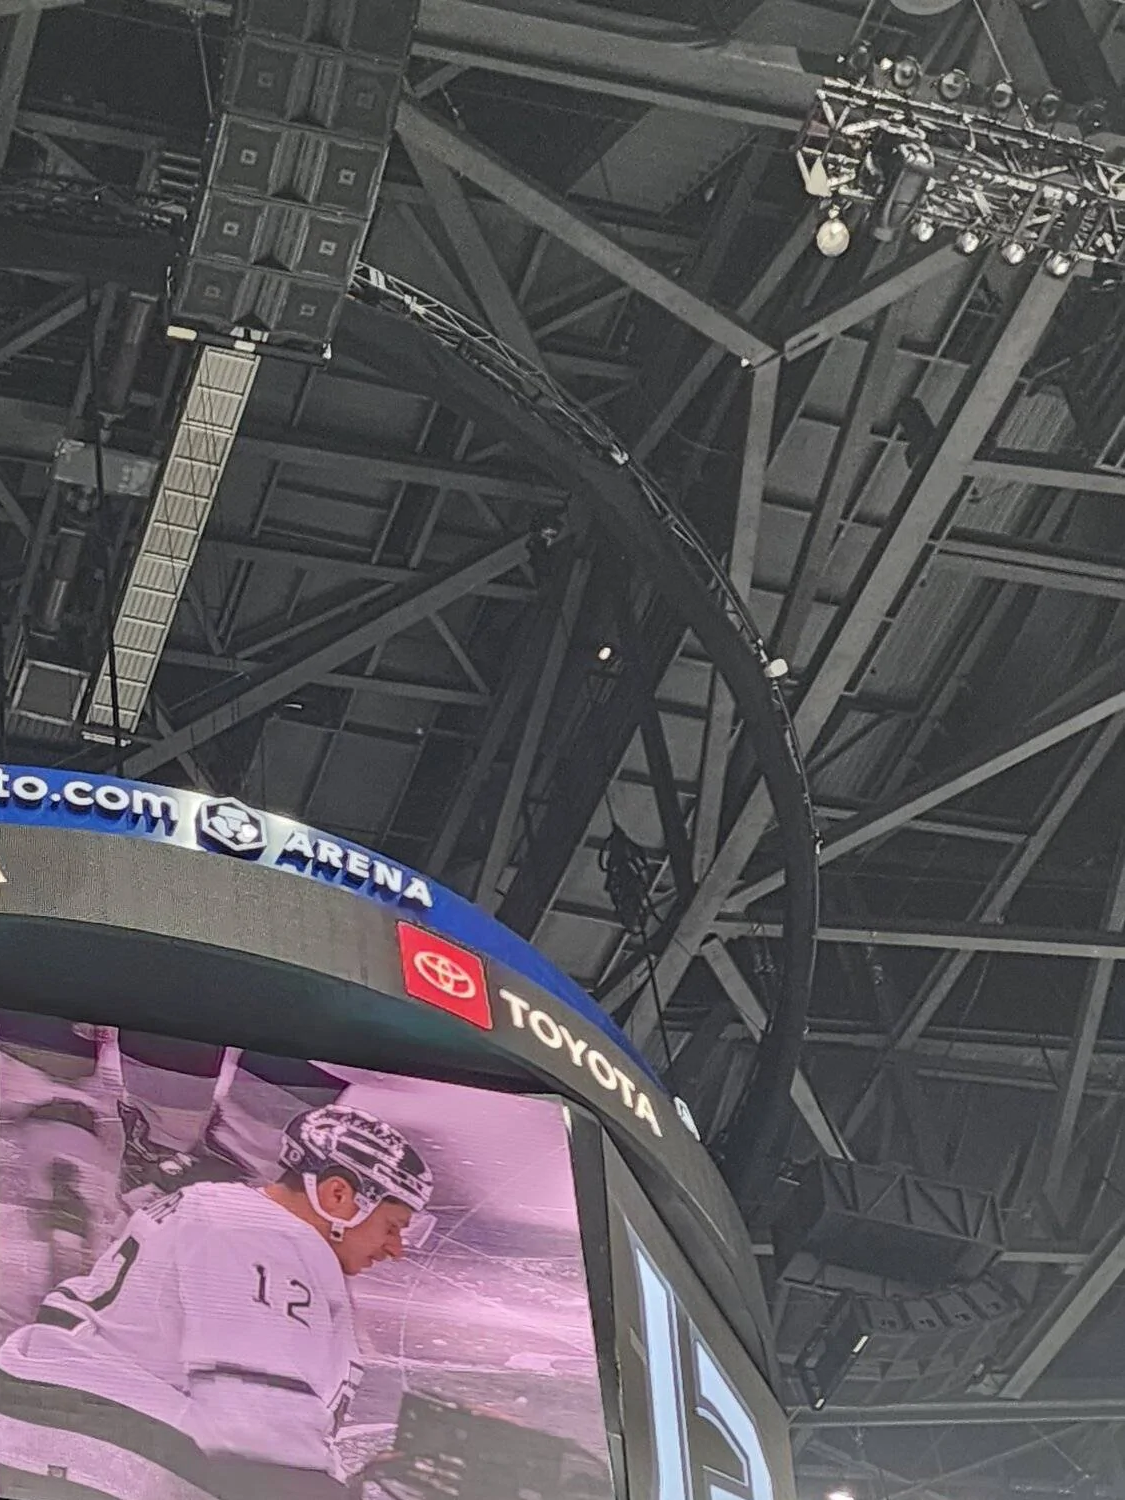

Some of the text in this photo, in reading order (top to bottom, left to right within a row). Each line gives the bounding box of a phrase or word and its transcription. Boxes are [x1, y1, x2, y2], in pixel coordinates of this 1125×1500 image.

[283, 830, 433, 907] ARENA
[500, 988, 663, 1137] TOYOTA
[252, 1264, 311, 1329] 12
